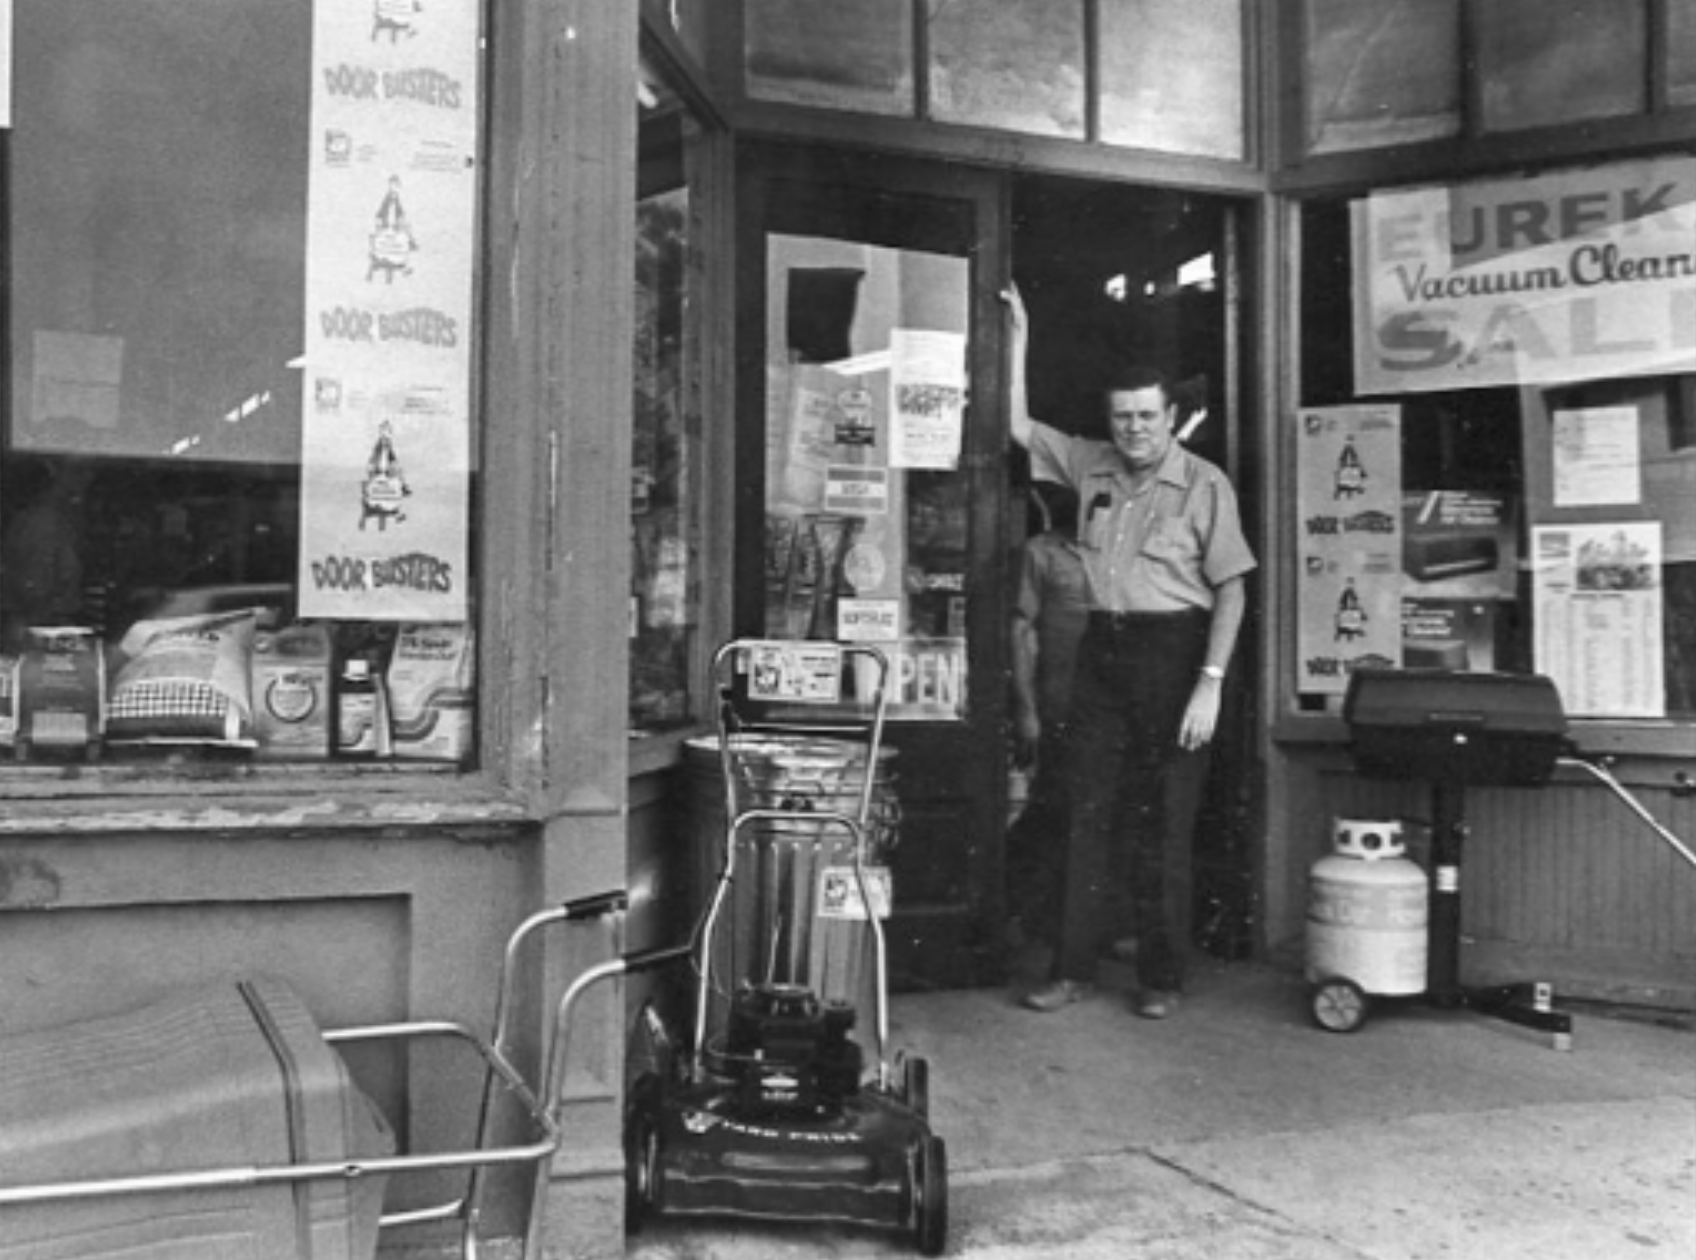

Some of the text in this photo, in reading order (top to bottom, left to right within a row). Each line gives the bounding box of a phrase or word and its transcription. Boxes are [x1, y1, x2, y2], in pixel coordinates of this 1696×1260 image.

[323, 63, 461, 109] DOOR BUSTERS
[1388, 263, 1567, 302] Vacuum
[320, 306, 457, 348] DOOR BUSTERS
[311, 552, 452, 594] DOOR BUSTERS
[886, 653, 959, 704] PEN
